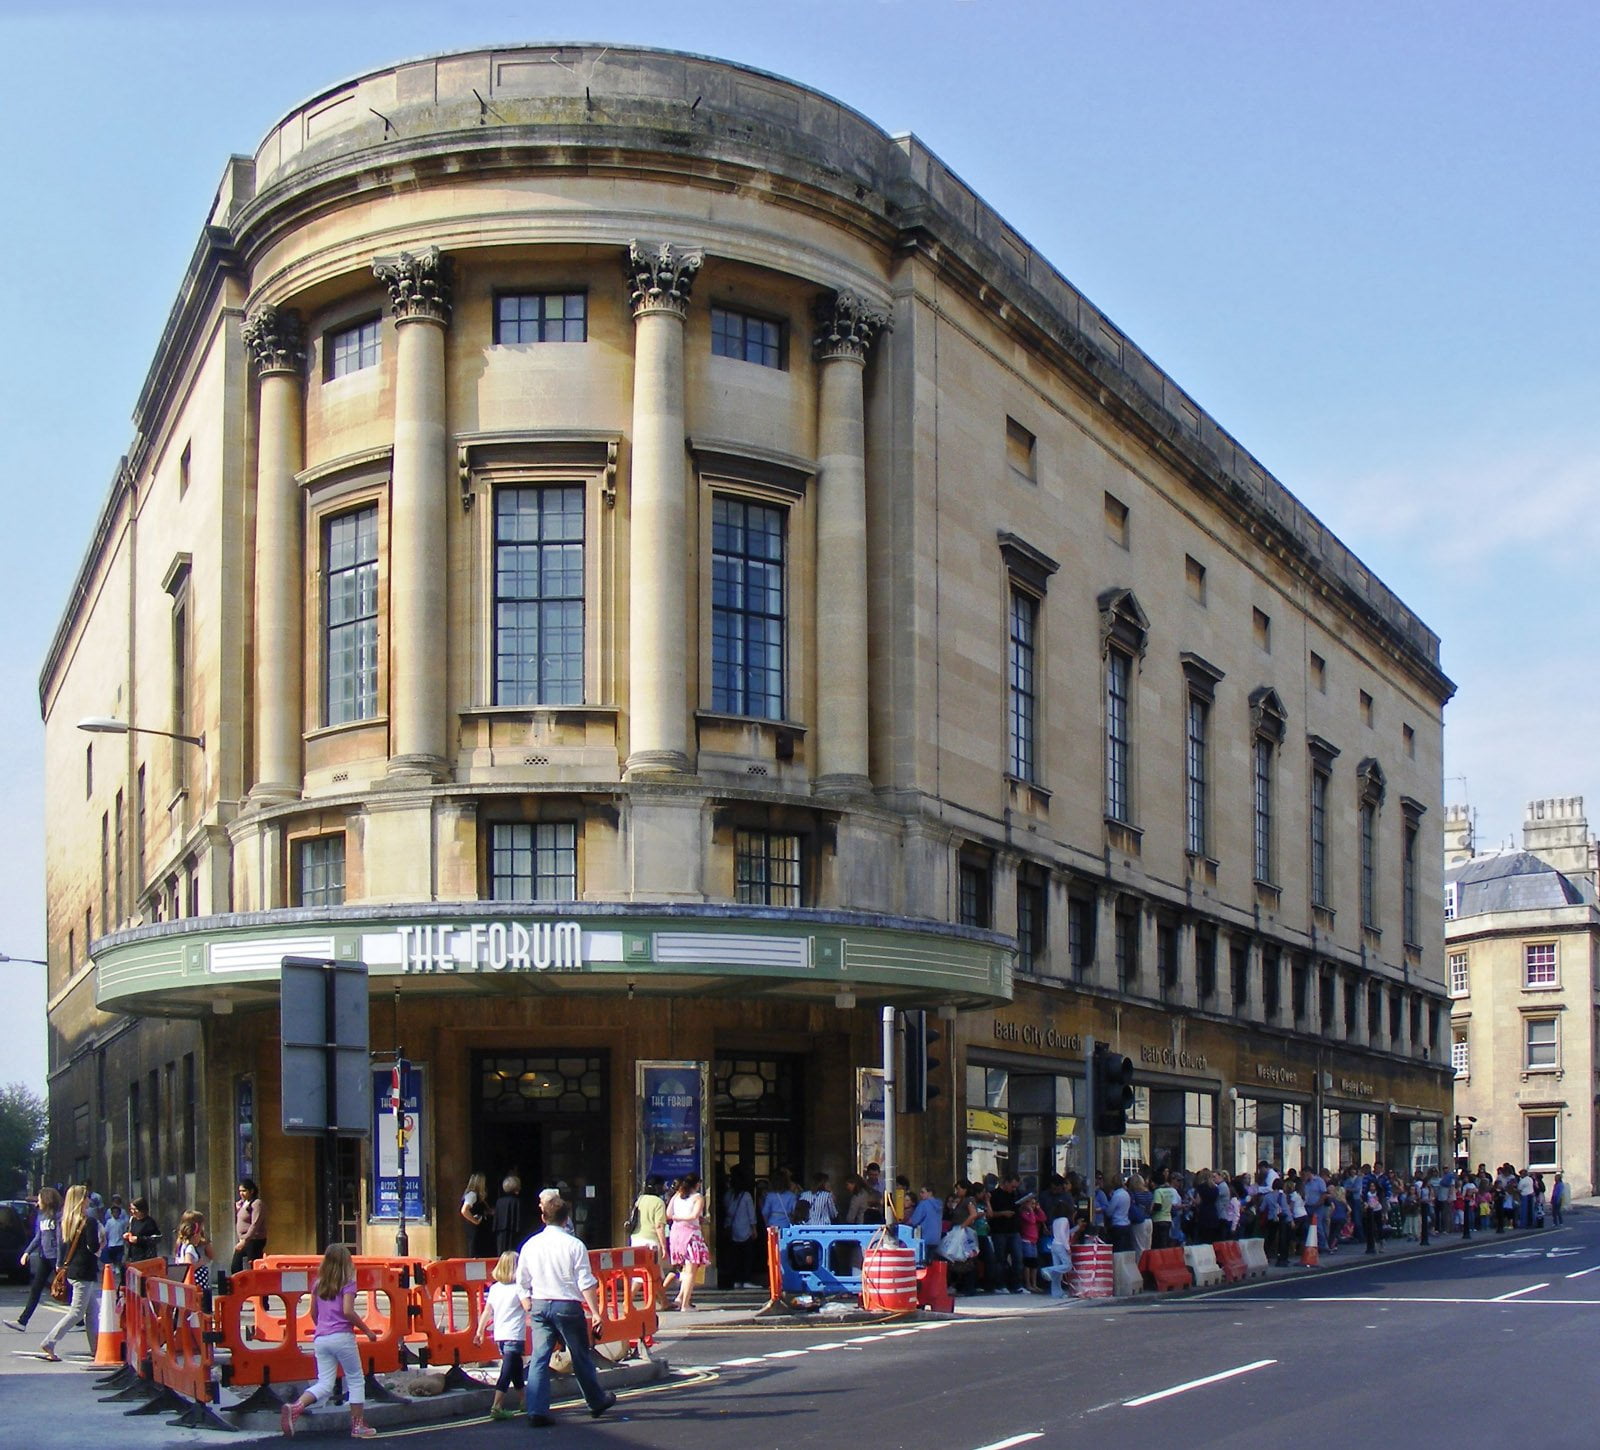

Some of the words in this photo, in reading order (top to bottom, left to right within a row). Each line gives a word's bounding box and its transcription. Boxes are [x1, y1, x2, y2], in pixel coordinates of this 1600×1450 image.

[397, 924, 454, 970] THE
[471, 921, 582, 970] FORUM
[993, 1019, 1020, 1041] Bath
[1022, 1024, 1045, 1048] City
[1047, 1028, 1083, 1051] Church
[1141, 1044, 1160, 1063] Bath
[1161, 1048, 1178, 1069] City
[1180, 1050, 1208, 1070] Church
[1256, 1063, 1279, 1083] Wesley
[1280, 1067, 1297, 1082] Owen
[1341, 1078, 1358, 1097] Wesley
[1359, 1080, 1374, 1095] Owen
[652, 1096, 664, 1107] THE
[668, 1096, 693, 1107] FORUM
